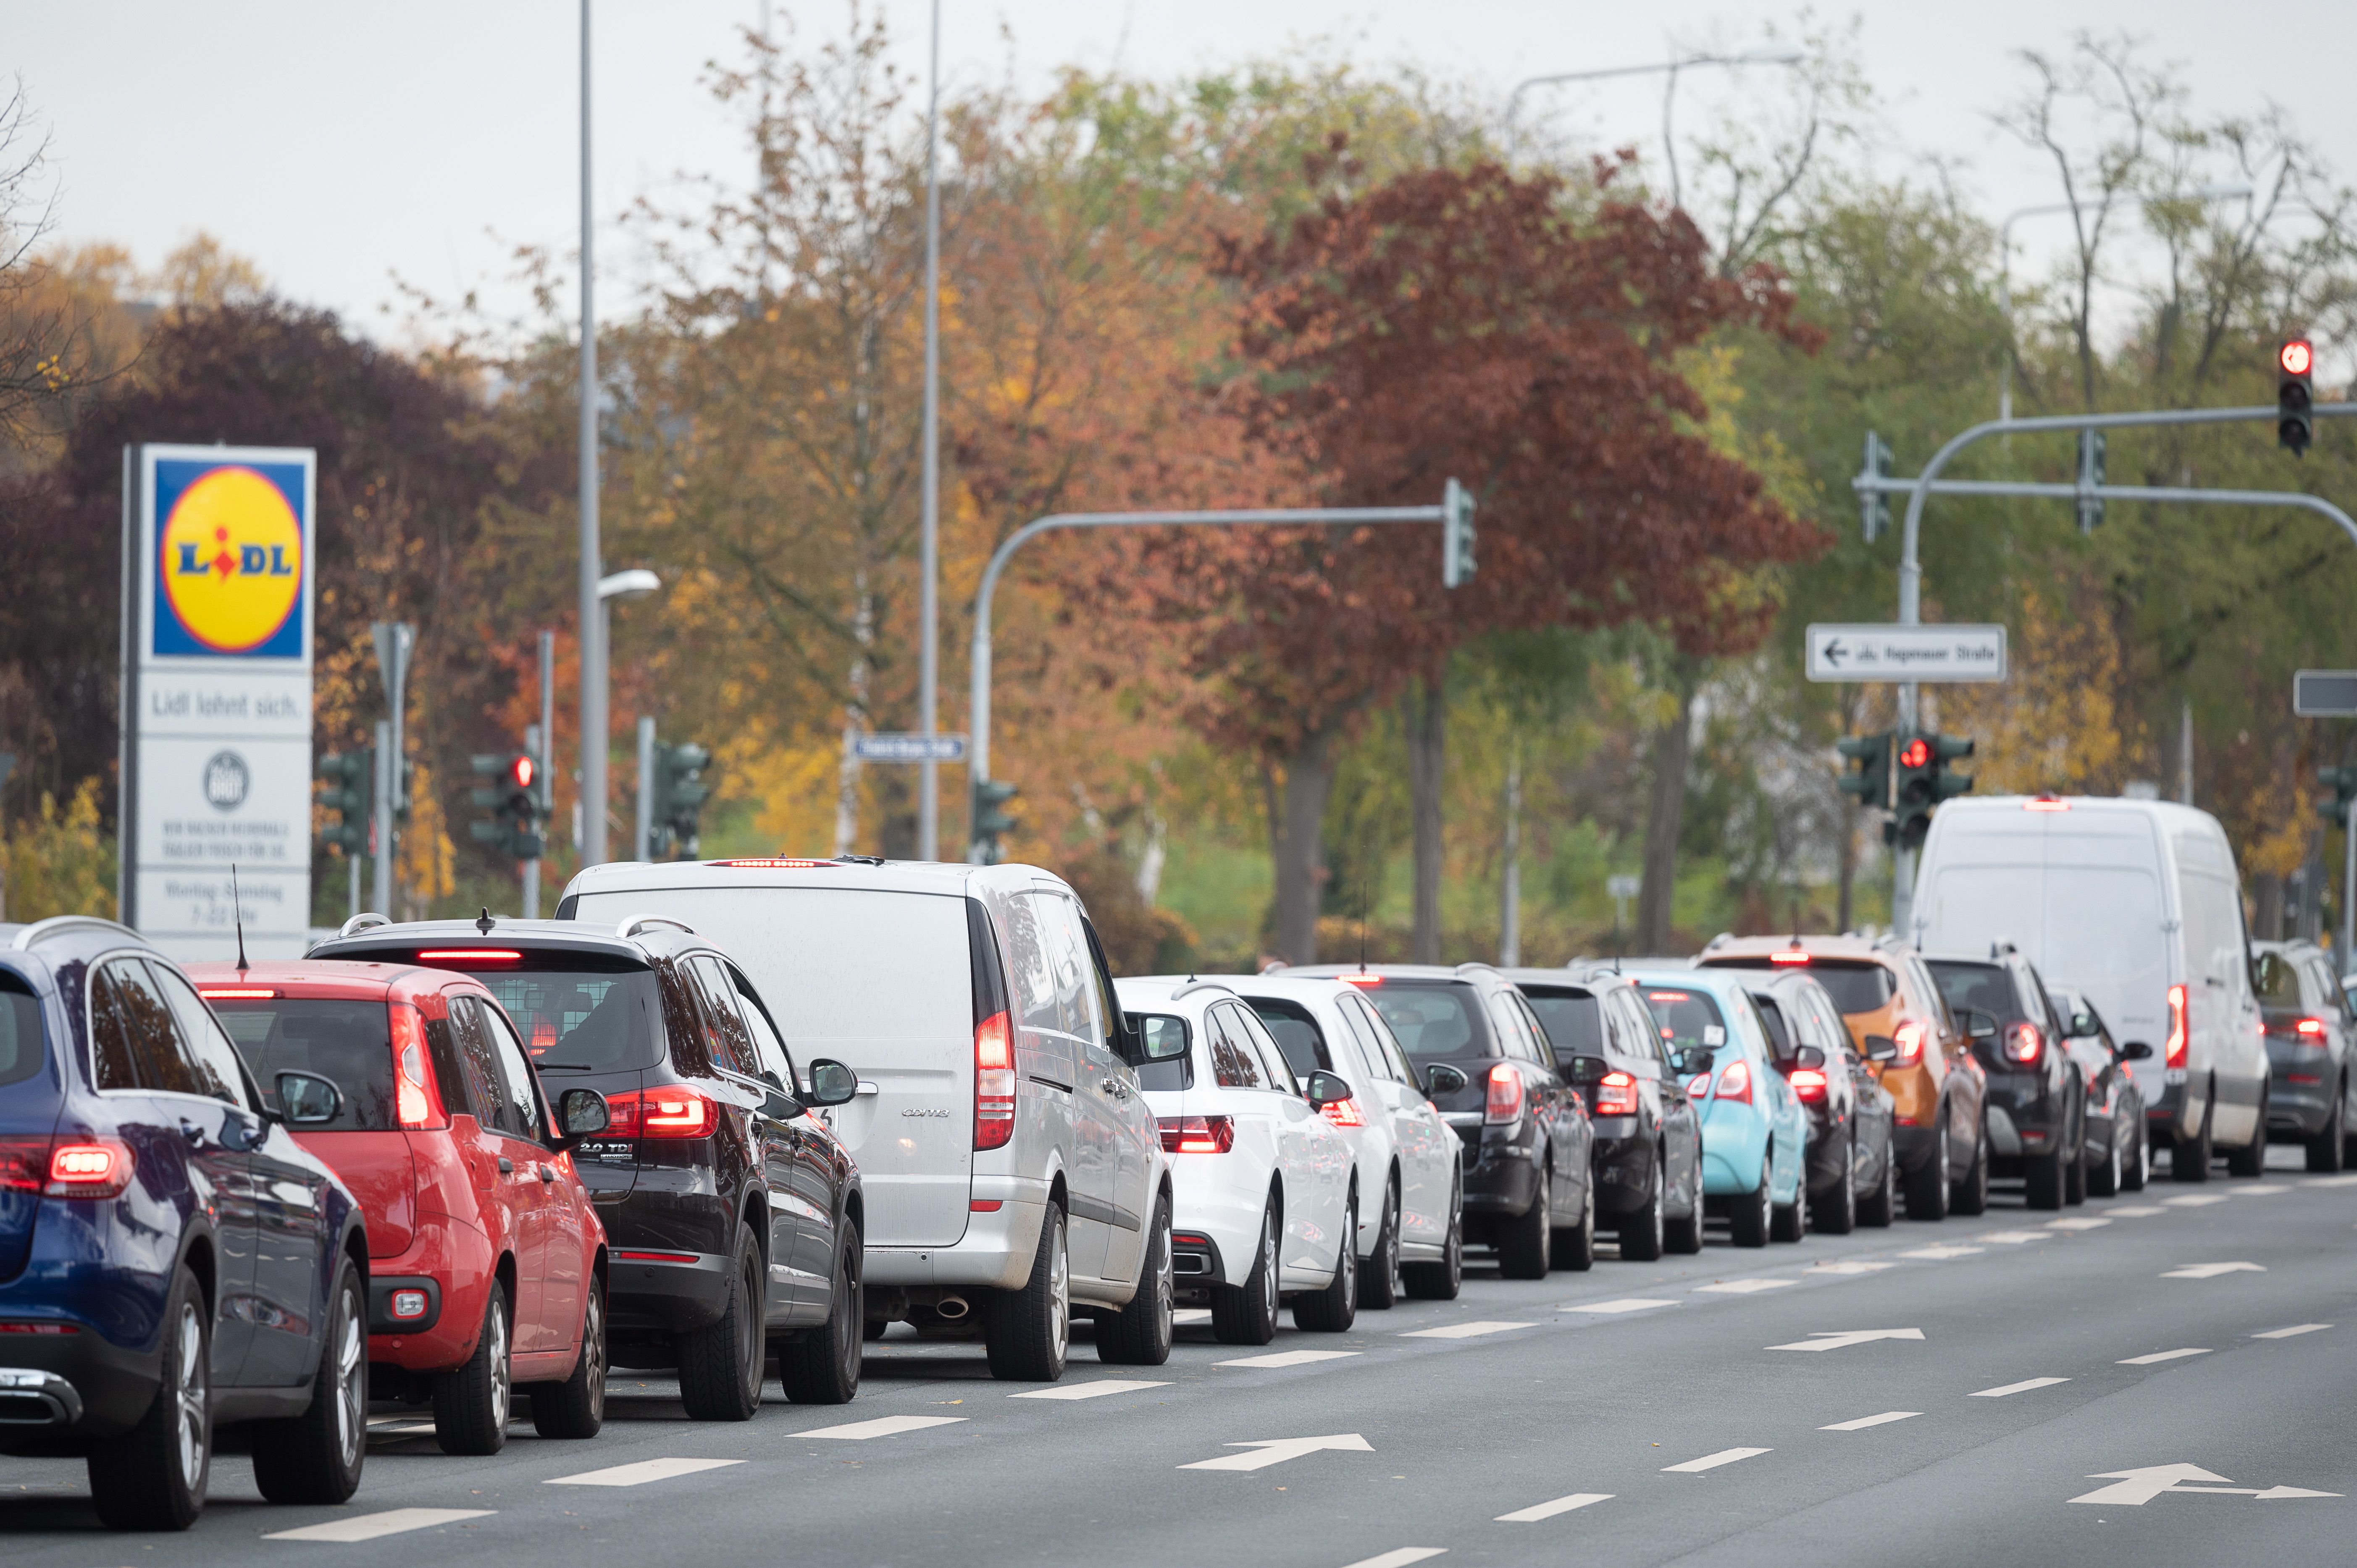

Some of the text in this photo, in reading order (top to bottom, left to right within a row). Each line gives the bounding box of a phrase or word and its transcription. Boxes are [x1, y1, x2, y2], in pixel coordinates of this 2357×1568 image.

[1956, 645, 1995, 662] Straße
[152, 691, 189, 715] Lidl
[196, 691, 248, 716] lohnt
[928, 1109, 949, 1117] 113
[580, 1143, 633, 1153] 2.0 TDI
